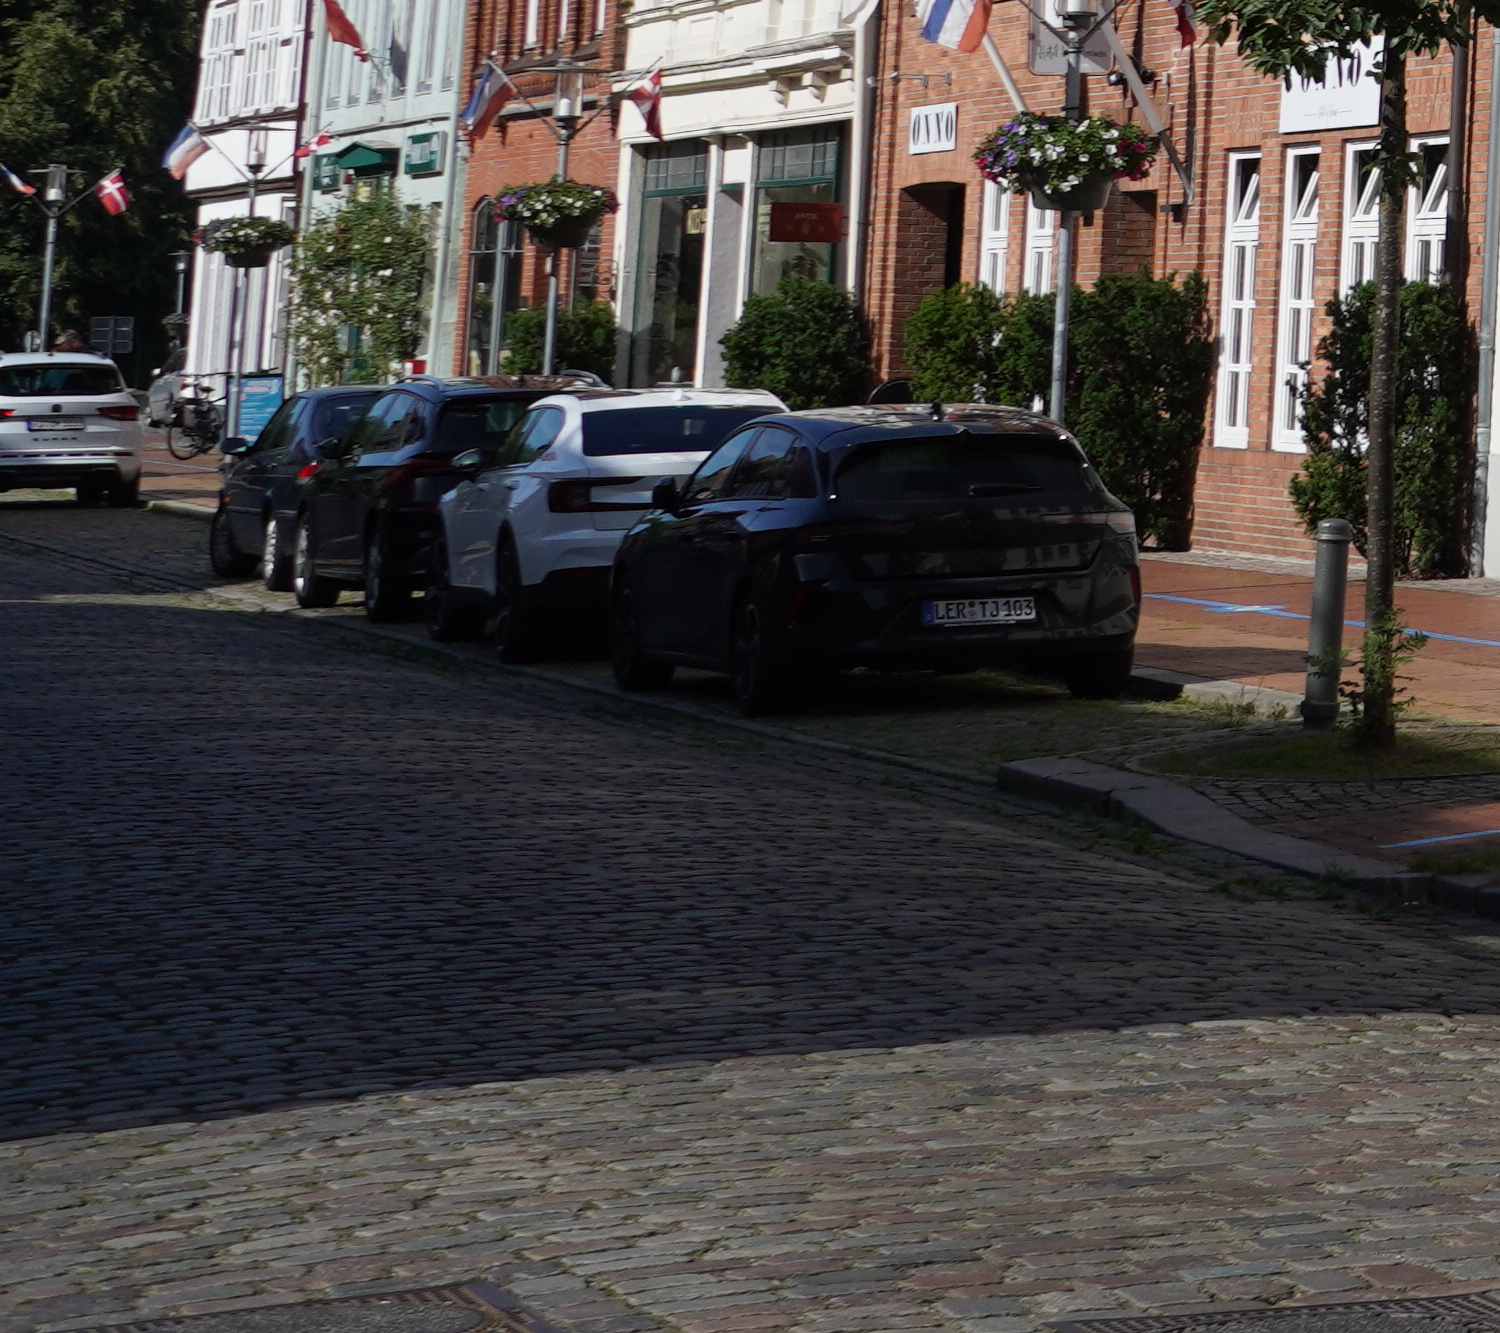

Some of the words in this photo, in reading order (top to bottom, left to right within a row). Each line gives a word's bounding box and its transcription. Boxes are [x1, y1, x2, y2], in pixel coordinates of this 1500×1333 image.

[935, 602, 966, 620] LER
[979, 600, 999, 618] TJ
[1002, 599, 1033, 617] 103
